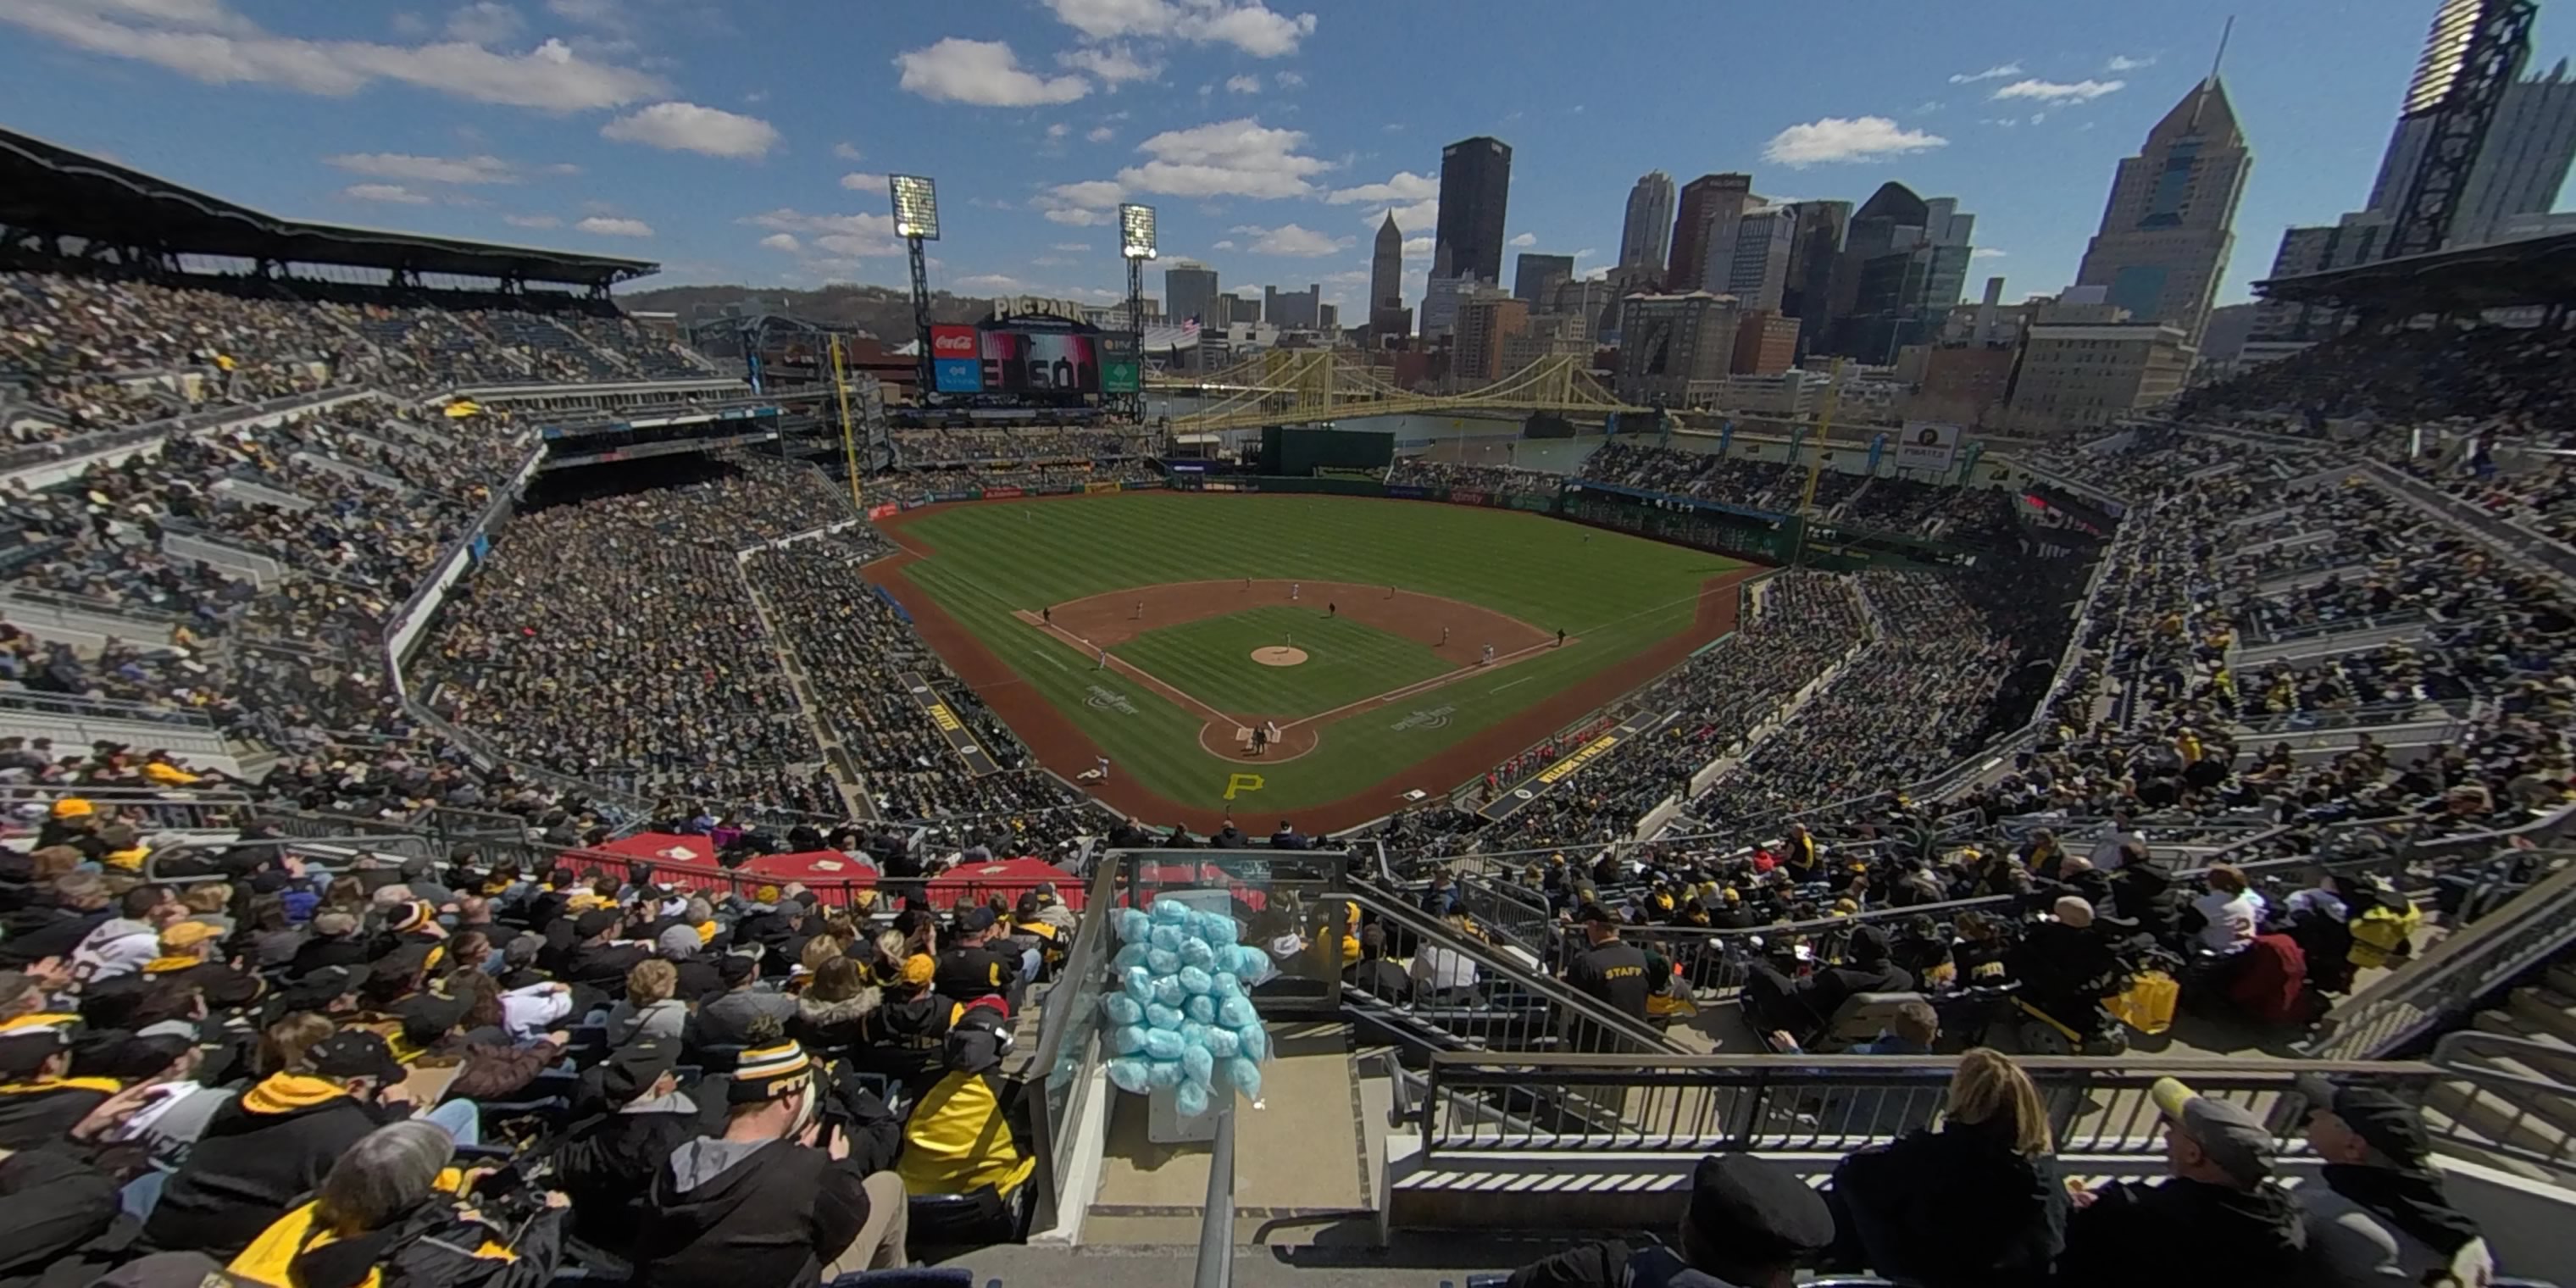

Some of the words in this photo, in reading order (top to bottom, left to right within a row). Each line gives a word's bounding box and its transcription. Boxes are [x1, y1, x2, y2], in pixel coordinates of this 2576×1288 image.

[994, 298, 1034, 322] PNC
[1036, 299, 1087, 325] PARK
[1452, 491, 1483, 504] xfinity
[1224, 773, 1265, 800] P
[1606, 967, 1642, 980] STAFF
